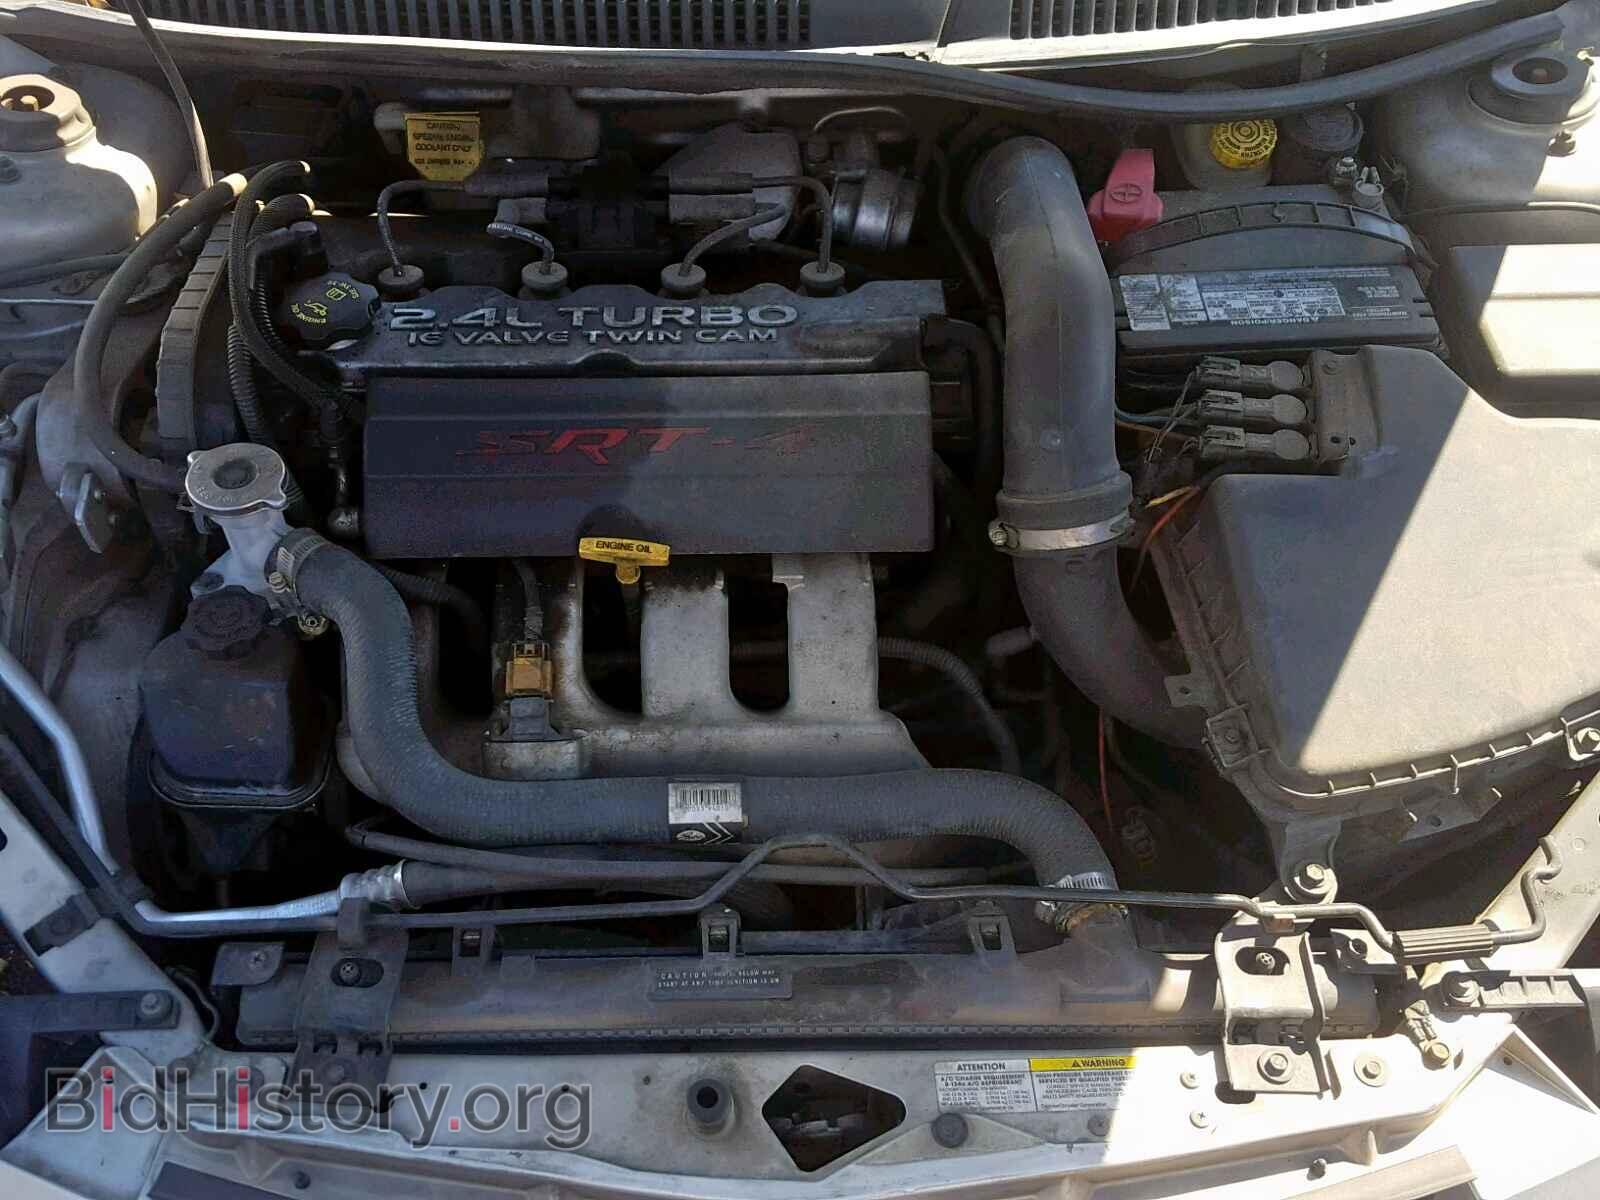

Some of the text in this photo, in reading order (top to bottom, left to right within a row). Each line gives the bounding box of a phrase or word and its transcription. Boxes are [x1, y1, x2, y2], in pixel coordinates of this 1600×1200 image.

[415, 143, 450, 152] COOLANT
[390, 303, 798, 331] 2.4L TURBO
[453, 330, 569, 345] VALVE
[583, 329, 683, 344] TWIN
[695, 328, 778, 343] CAM
[456, 426, 816, 465] SRT-4
[595, 540, 653, 554] ENGINE OIL
[956, 1062, 1006, 1072] ATTENTION
[1082, 1058, 1126, 1068] WARNING
